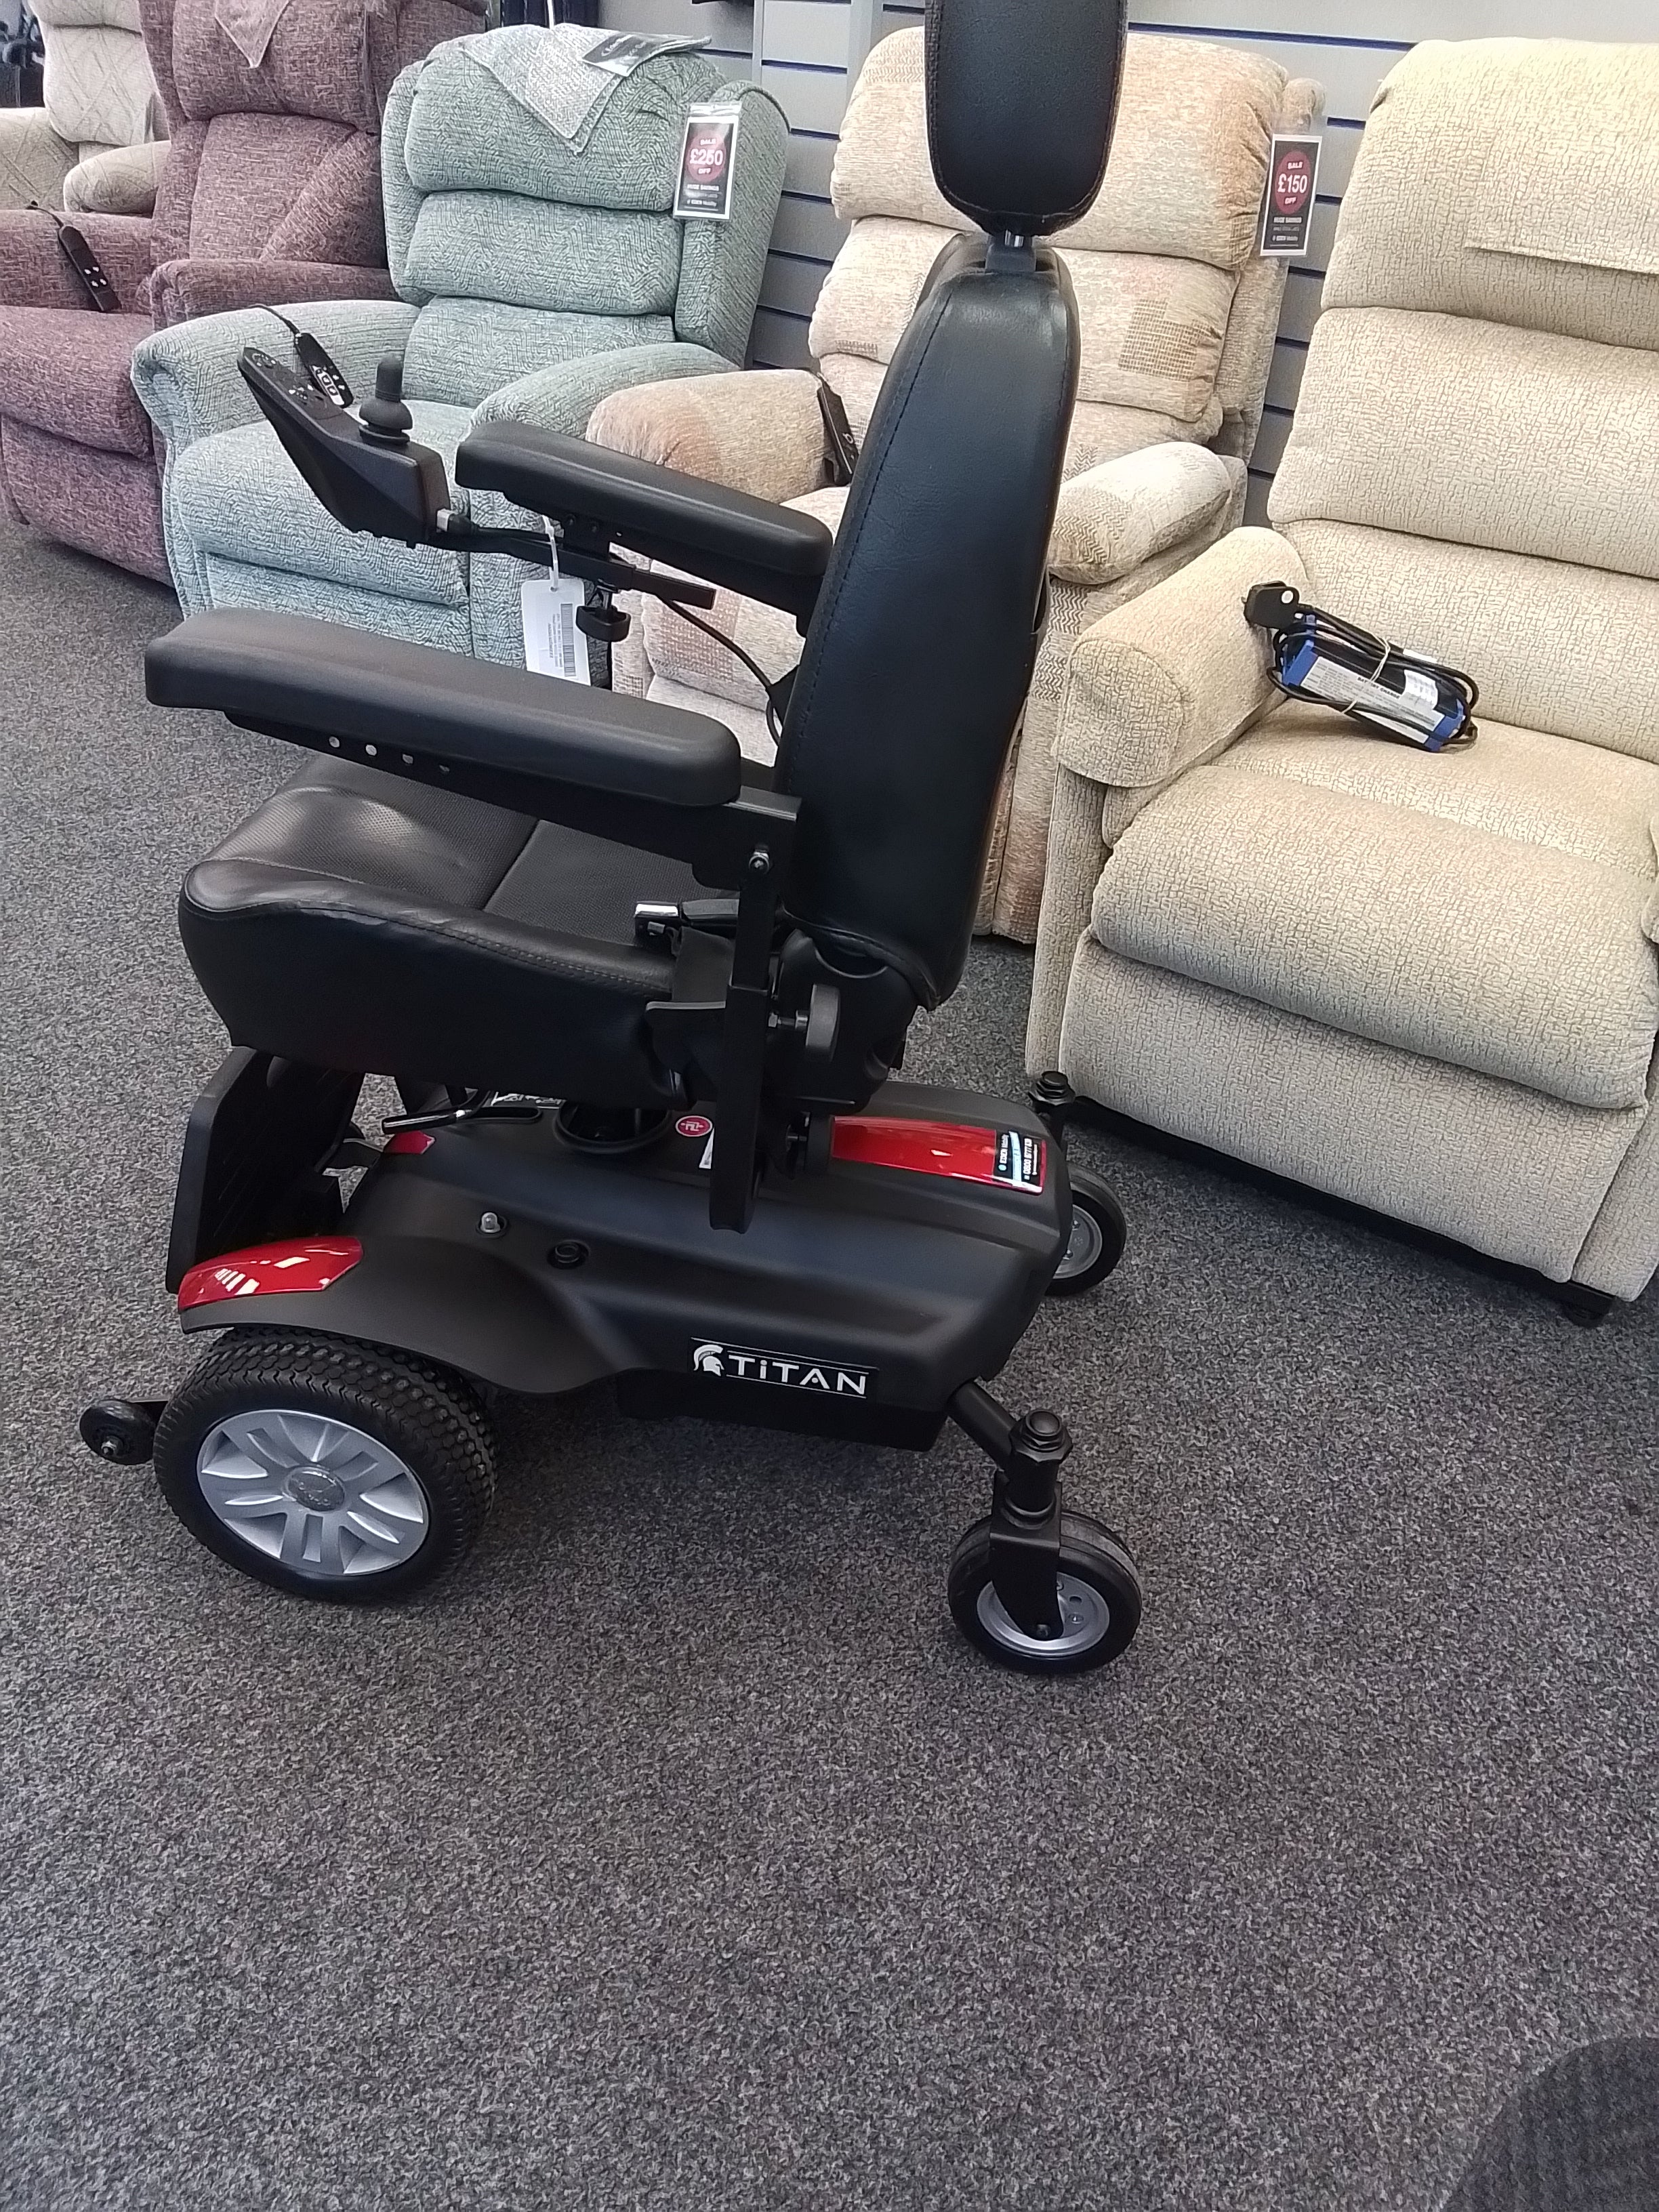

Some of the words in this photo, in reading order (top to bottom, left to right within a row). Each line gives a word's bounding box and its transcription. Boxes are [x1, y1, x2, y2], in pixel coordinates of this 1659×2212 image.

[689, 148, 723, 166] £250
[1288, 161, 1303, 169] SALE
[1277, 173, 1308, 193] £150
[1284, 197, 1296, 205] OFF
[1357, 677, 1379, 689] BATERY
